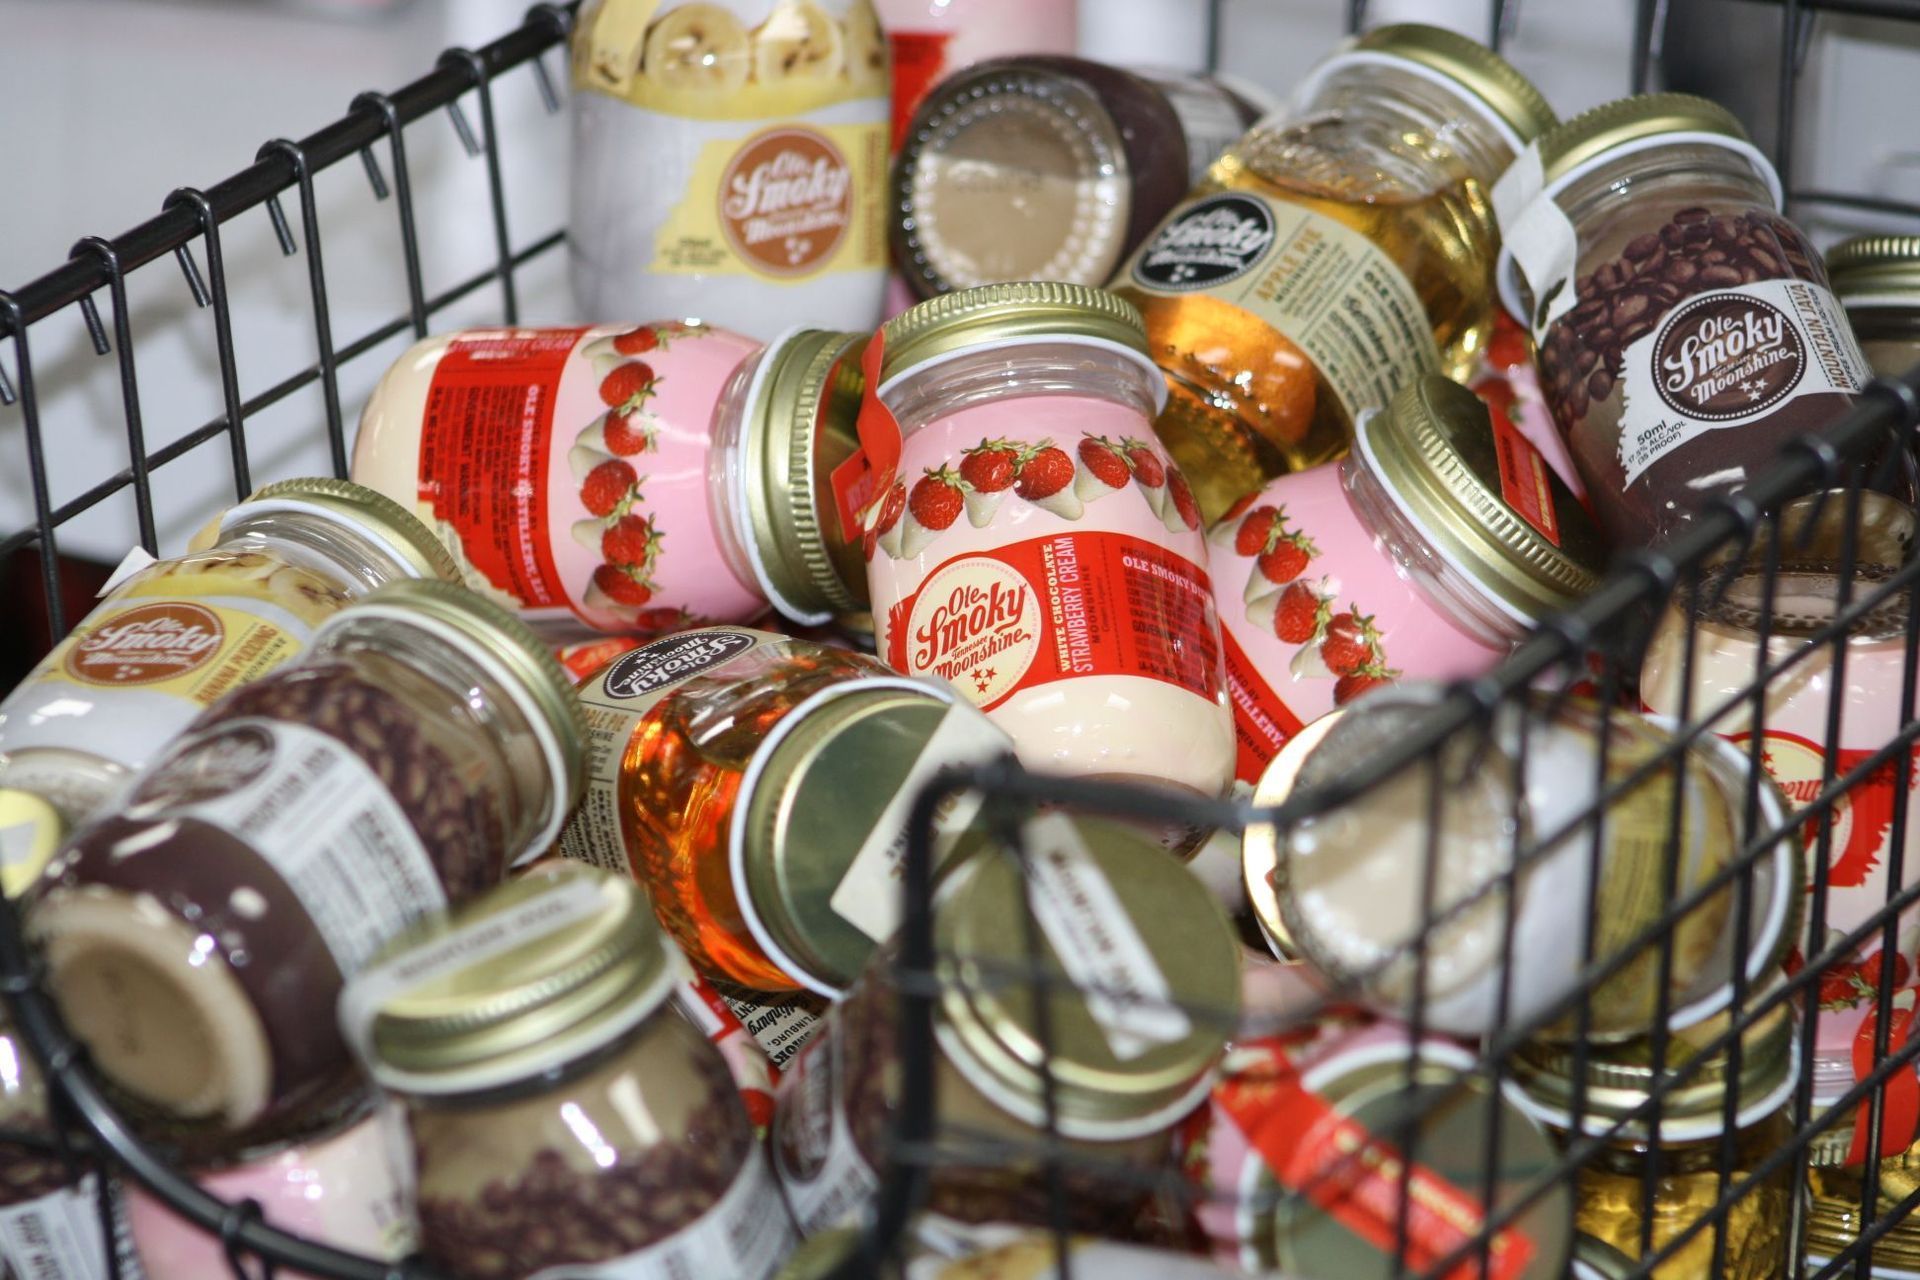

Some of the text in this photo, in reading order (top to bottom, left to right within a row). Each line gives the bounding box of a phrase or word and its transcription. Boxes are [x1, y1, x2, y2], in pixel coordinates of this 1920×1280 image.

[1254, 250, 1301, 303] APPLE
[1291, 226, 1323, 258] PIE
[1664, 311, 1787, 393] Smoky
[1699, 315, 1743, 344] Ole
[1791, 284, 1851, 390] MOUNTAIN JAVA
[524, 384, 539, 416] OLE
[1690, 346, 1798, 406] Moonshine
[517, 418, 534, 477] SMOKY
[1636, 419, 1667, 446] 50ml
[1649, 431, 1683, 458] PROOF)
[1122, 555, 1191, 590] OLE SMOKY
[915, 581, 1027, 671] Smoky
[949, 585, 988, 616] Ole
[1042, 543, 1071, 672] WHITE CHOCOLATE
[1053, 536, 1093, 673] STRAWBERRY CREAM
[1082, 565, 1101, 644] MOONSHINE
[82, 621, 219, 656] Smoky
[235, 623, 279, 670] PUDDING
[614, 635, 711, 690] Moonshine
[631, 635, 743, 696] Smoky
[677, 654, 713, 672] Ole
[932, 628, 1032, 681] Moonshine
[951, 635, 988, 660] Tennessee
